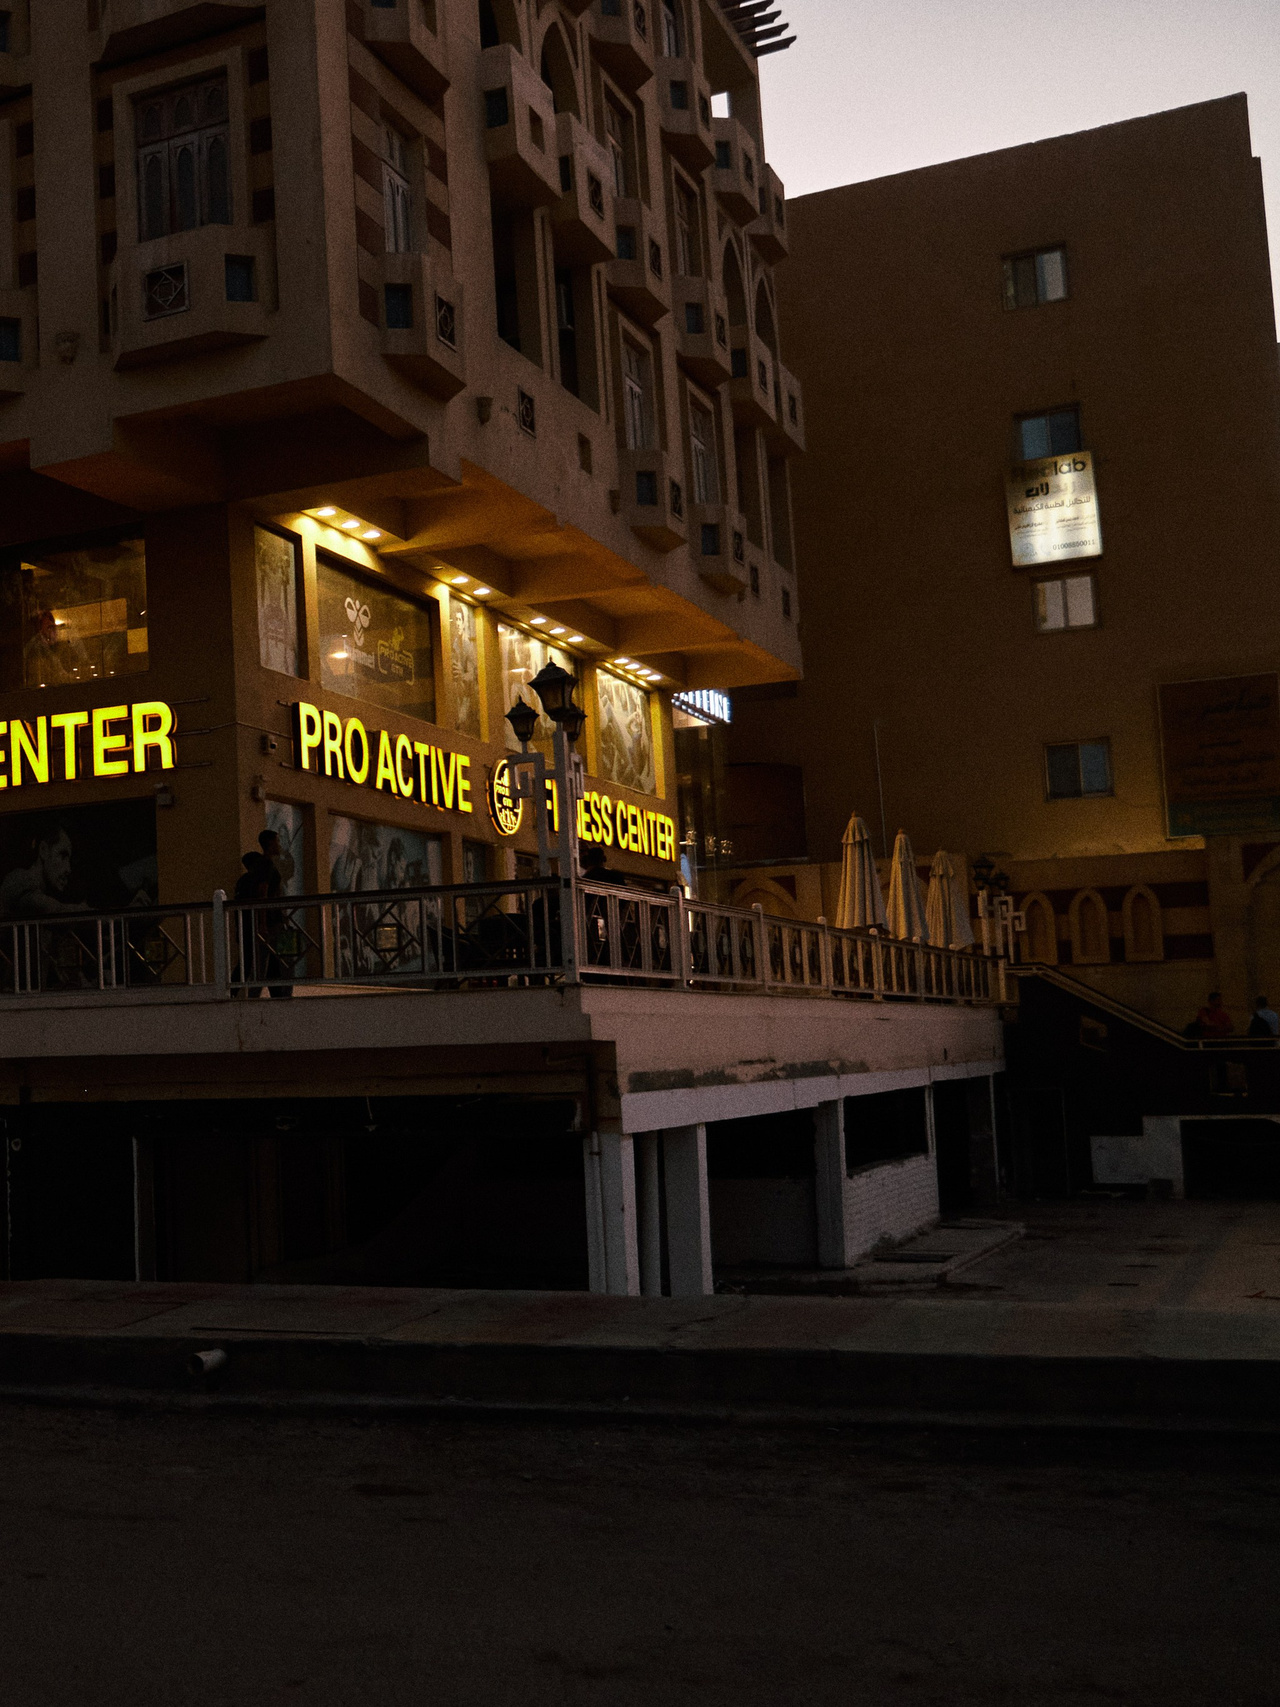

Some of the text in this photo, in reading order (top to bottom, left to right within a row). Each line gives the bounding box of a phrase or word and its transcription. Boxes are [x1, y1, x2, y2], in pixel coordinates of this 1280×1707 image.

[1053, 457, 1087, 475] lab
[1044, 500, 1065, 510] الطبية
[297, 701, 473, 813] PRO ACTIVE
[616, 799, 676, 862] CENTER
